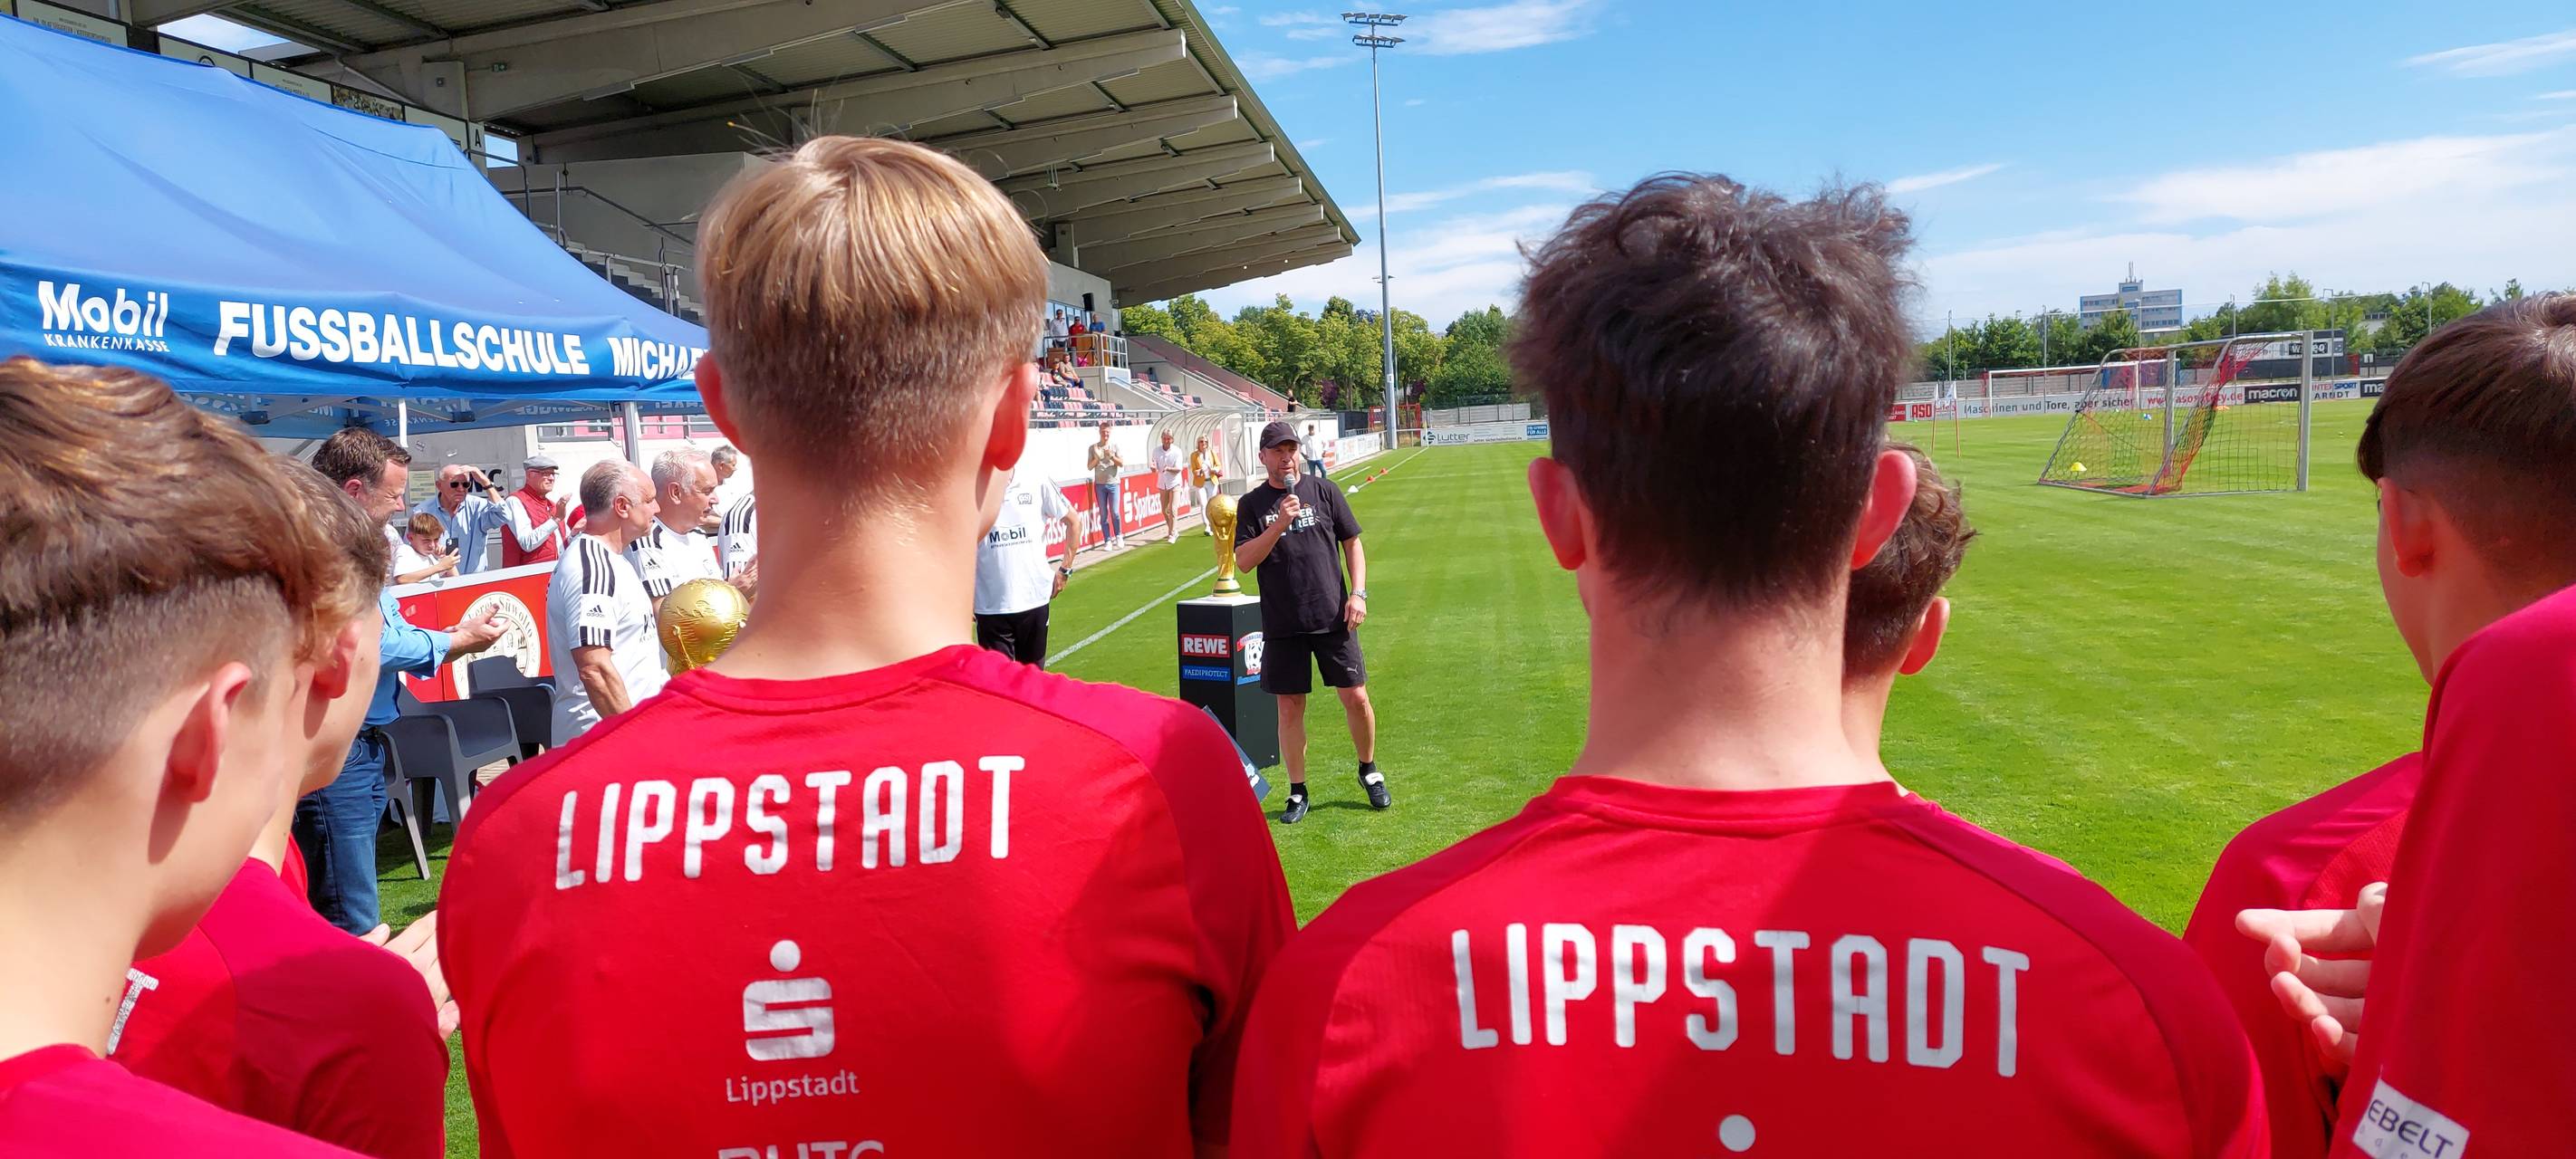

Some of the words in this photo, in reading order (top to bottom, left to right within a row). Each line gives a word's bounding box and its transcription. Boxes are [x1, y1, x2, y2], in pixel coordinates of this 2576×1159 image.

[475, 129, 482, 148] A
[38, 281, 168, 338] Mobil
[43, 333, 171, 352] KRANKENKASSE
[214, 301, 590, 375] FUSSBALLSCHULE
[607, 337, 709, 380] MICHAE
[2248, 387, 2298, 399] macron
[2314, 390, 2350, 399] ARNDT
[2023, 400, 2042, 411] und
[2045, 400, 2071, 412] Tore,
[2102, 398, 2134, 407] sicher
[1265, 507, 1314, 524] FOER
[989, 526, 1026, 543] Mobil
[1183, 637, 1228, 655] REWE
[555, 755, 1025, 890] LIPPSTADT
[1452, 923, 2030, 1078] LIPPSTADT
[726, 1068, 860, 1106] Lippstadt
